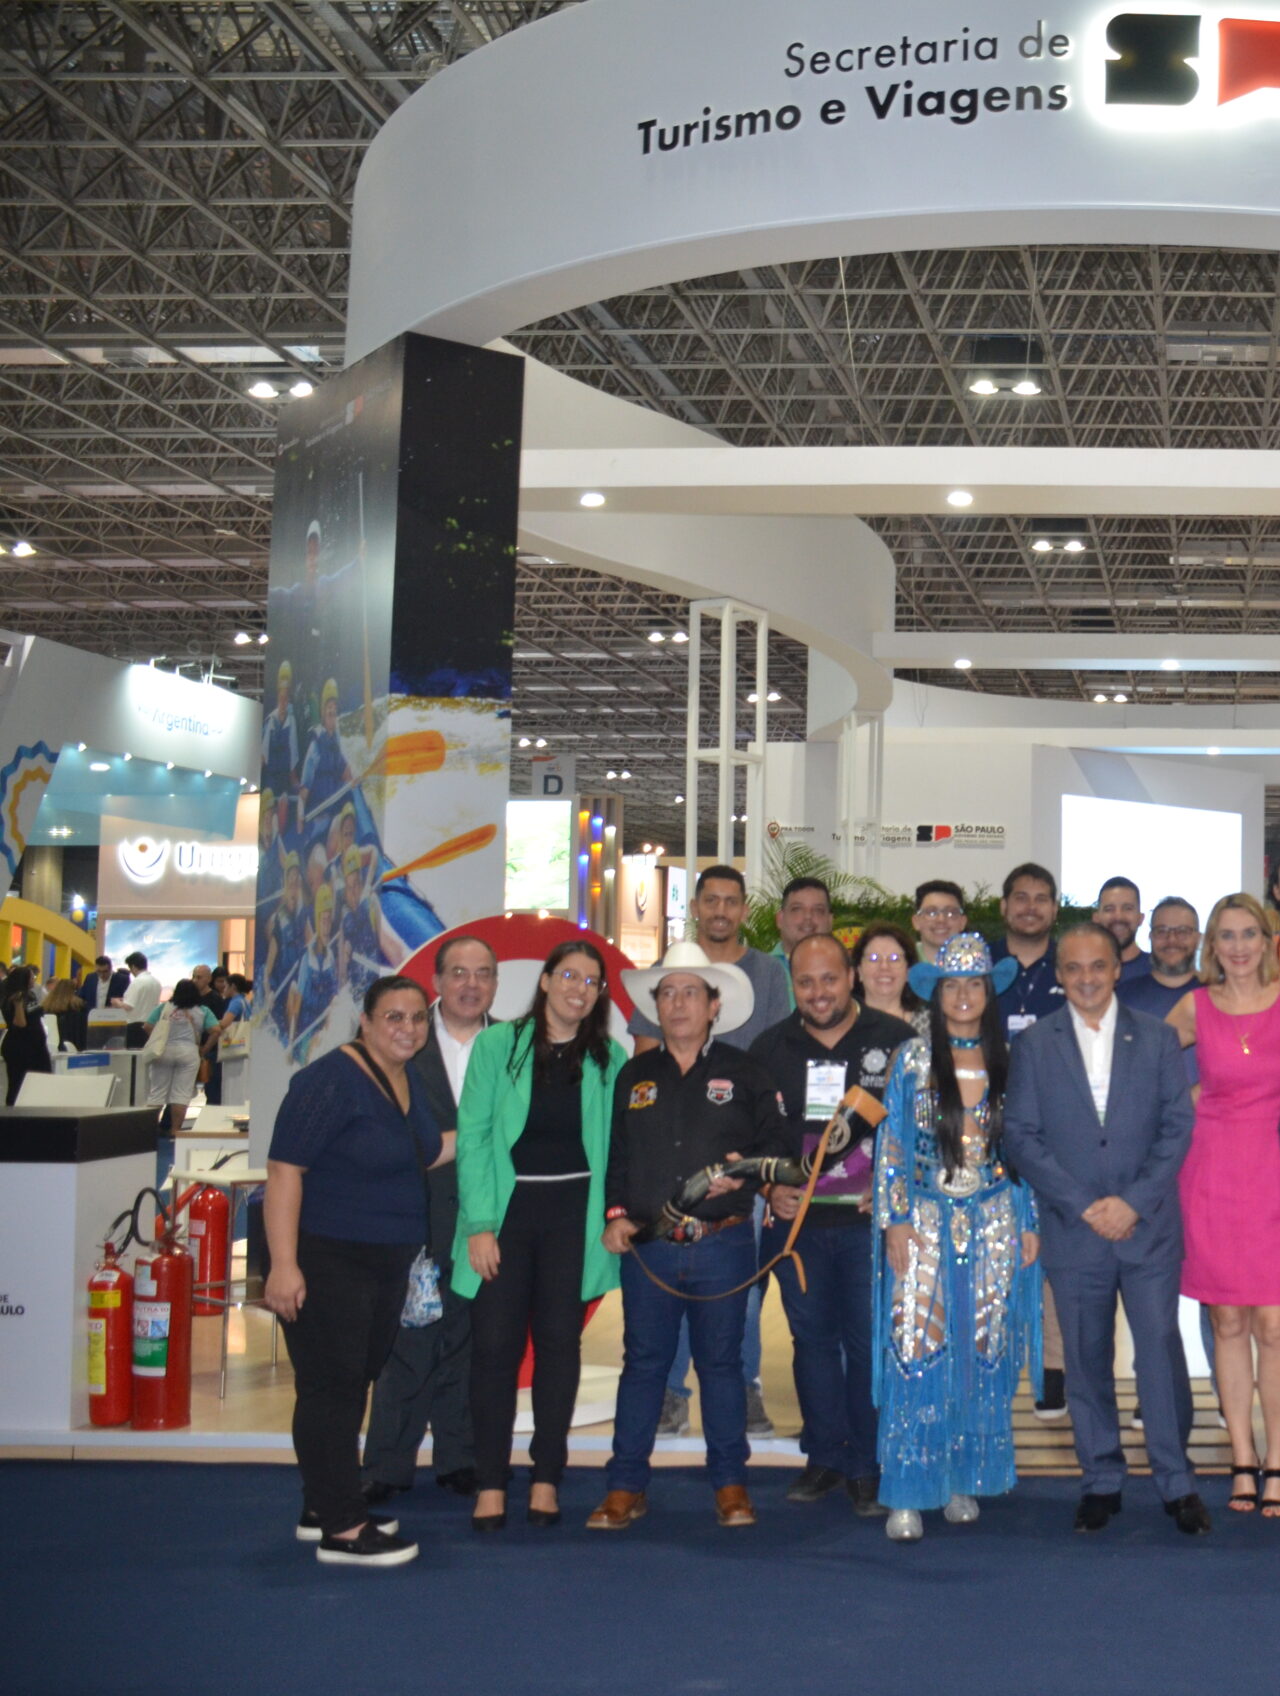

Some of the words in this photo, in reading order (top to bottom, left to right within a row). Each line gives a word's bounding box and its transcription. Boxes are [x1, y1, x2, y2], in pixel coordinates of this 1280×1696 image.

[784, 27, 998, 79] Secretaria
[1018, 20, 1070, 59] de
[637, 107, 802, 156] Turismo
[819, 99, 847, 125] e
[865, 81, 1069, 125] Viagens
[151, 707, 210, 736] Argentina
[543, 774, 563, 795] D
[881, 834, 912, 844] iagens
[954, 823, 973, 834] SÃO
[975, 825, 1005, 834] PAULO
[0, 1305, 25, 1316] ULO
